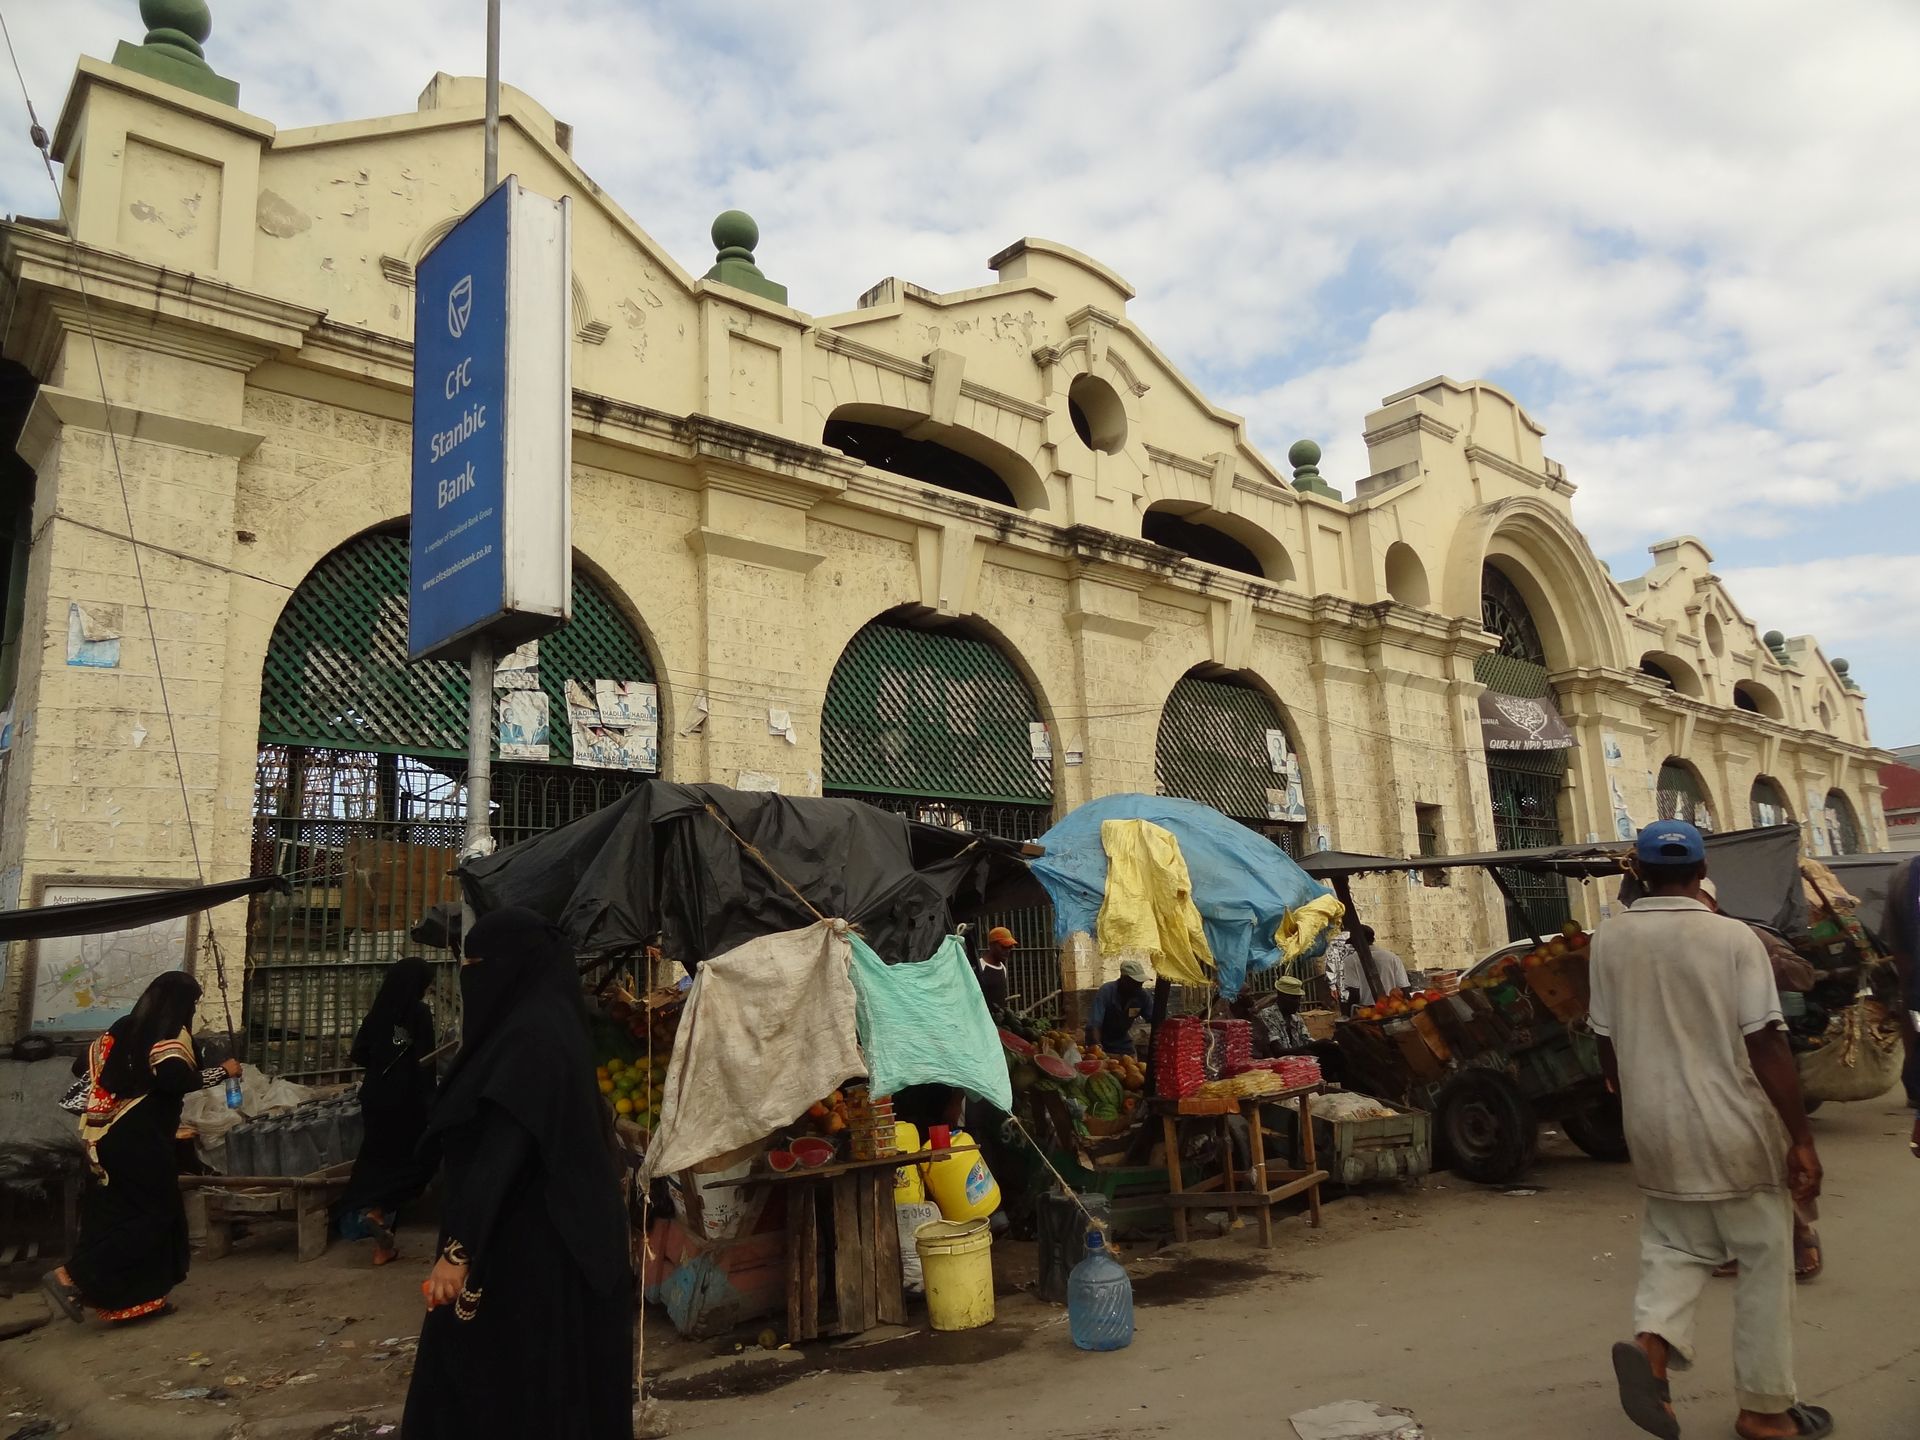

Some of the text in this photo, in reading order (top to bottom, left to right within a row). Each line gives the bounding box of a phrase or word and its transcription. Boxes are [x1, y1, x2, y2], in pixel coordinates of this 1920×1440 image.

[445, 357, 472, 400] CfC
[430, 403, 486, 463] Stanbic
[438, 460, 476, 509] Bank
